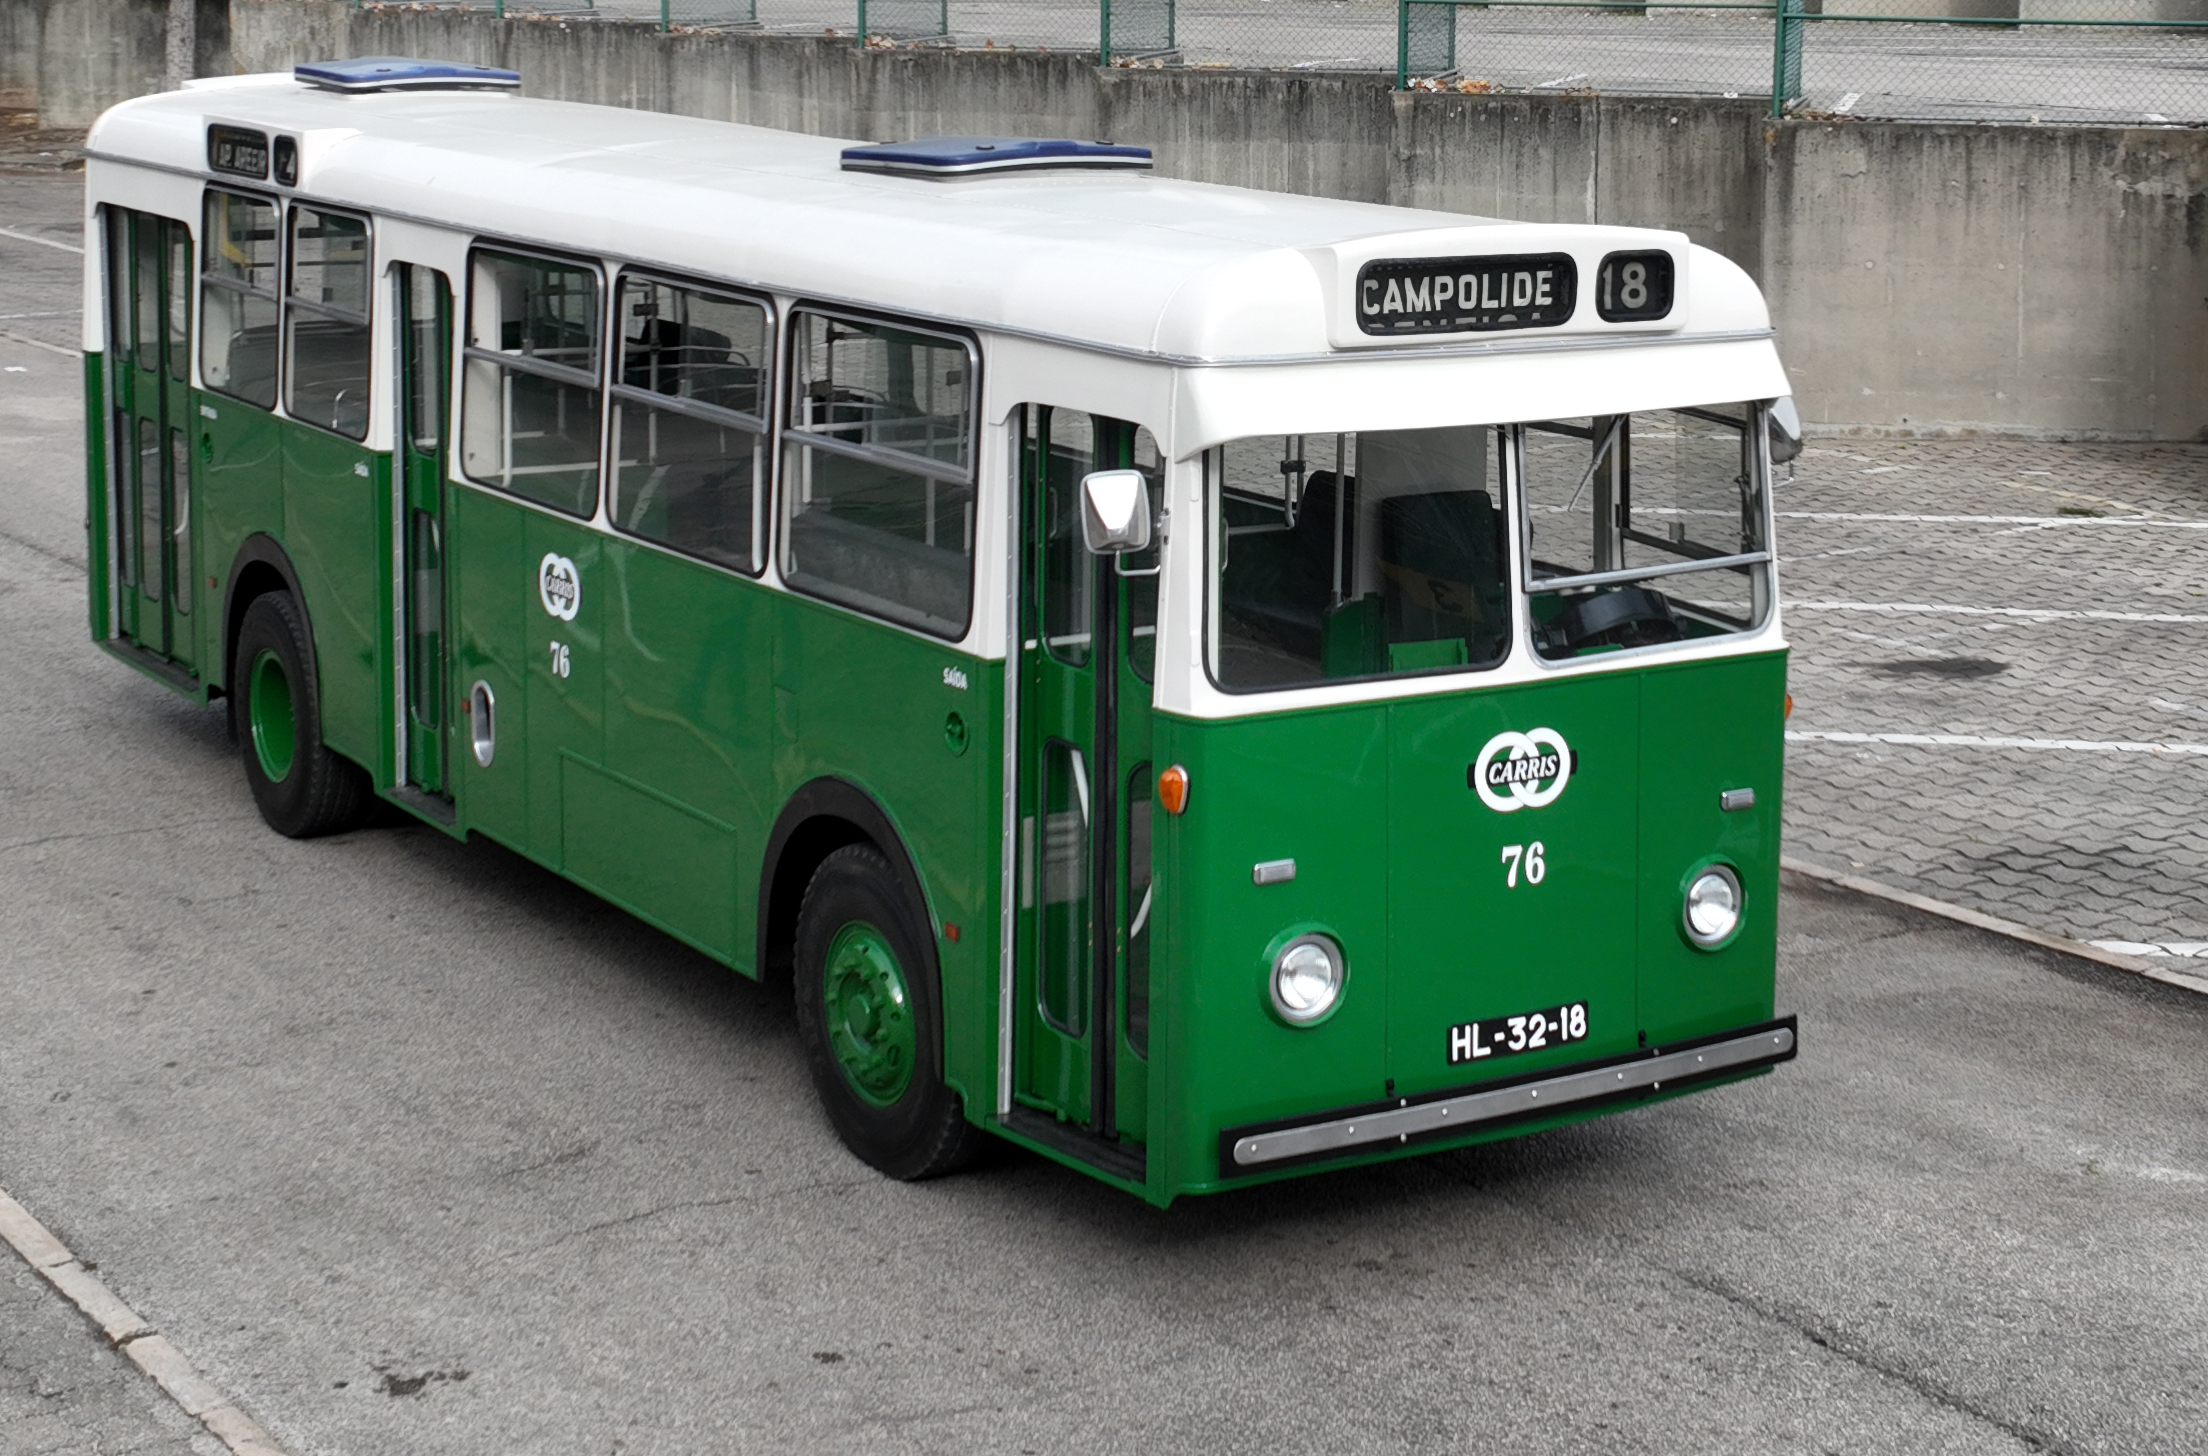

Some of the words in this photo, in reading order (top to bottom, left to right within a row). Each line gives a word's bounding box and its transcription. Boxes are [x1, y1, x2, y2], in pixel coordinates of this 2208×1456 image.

[1363, 270, 1553, 315] CAMPOLIDE
[1603, 261, 1647, 310] 18
[545, 575, 574, 600] CARRIS
[550, 640, 570, 678] 76
[1488, 754, 1558, 784] CARRIS
[1501, 841, 1545, 888] 76
[1452, 1004, 1587, 1062] HL-32-18
